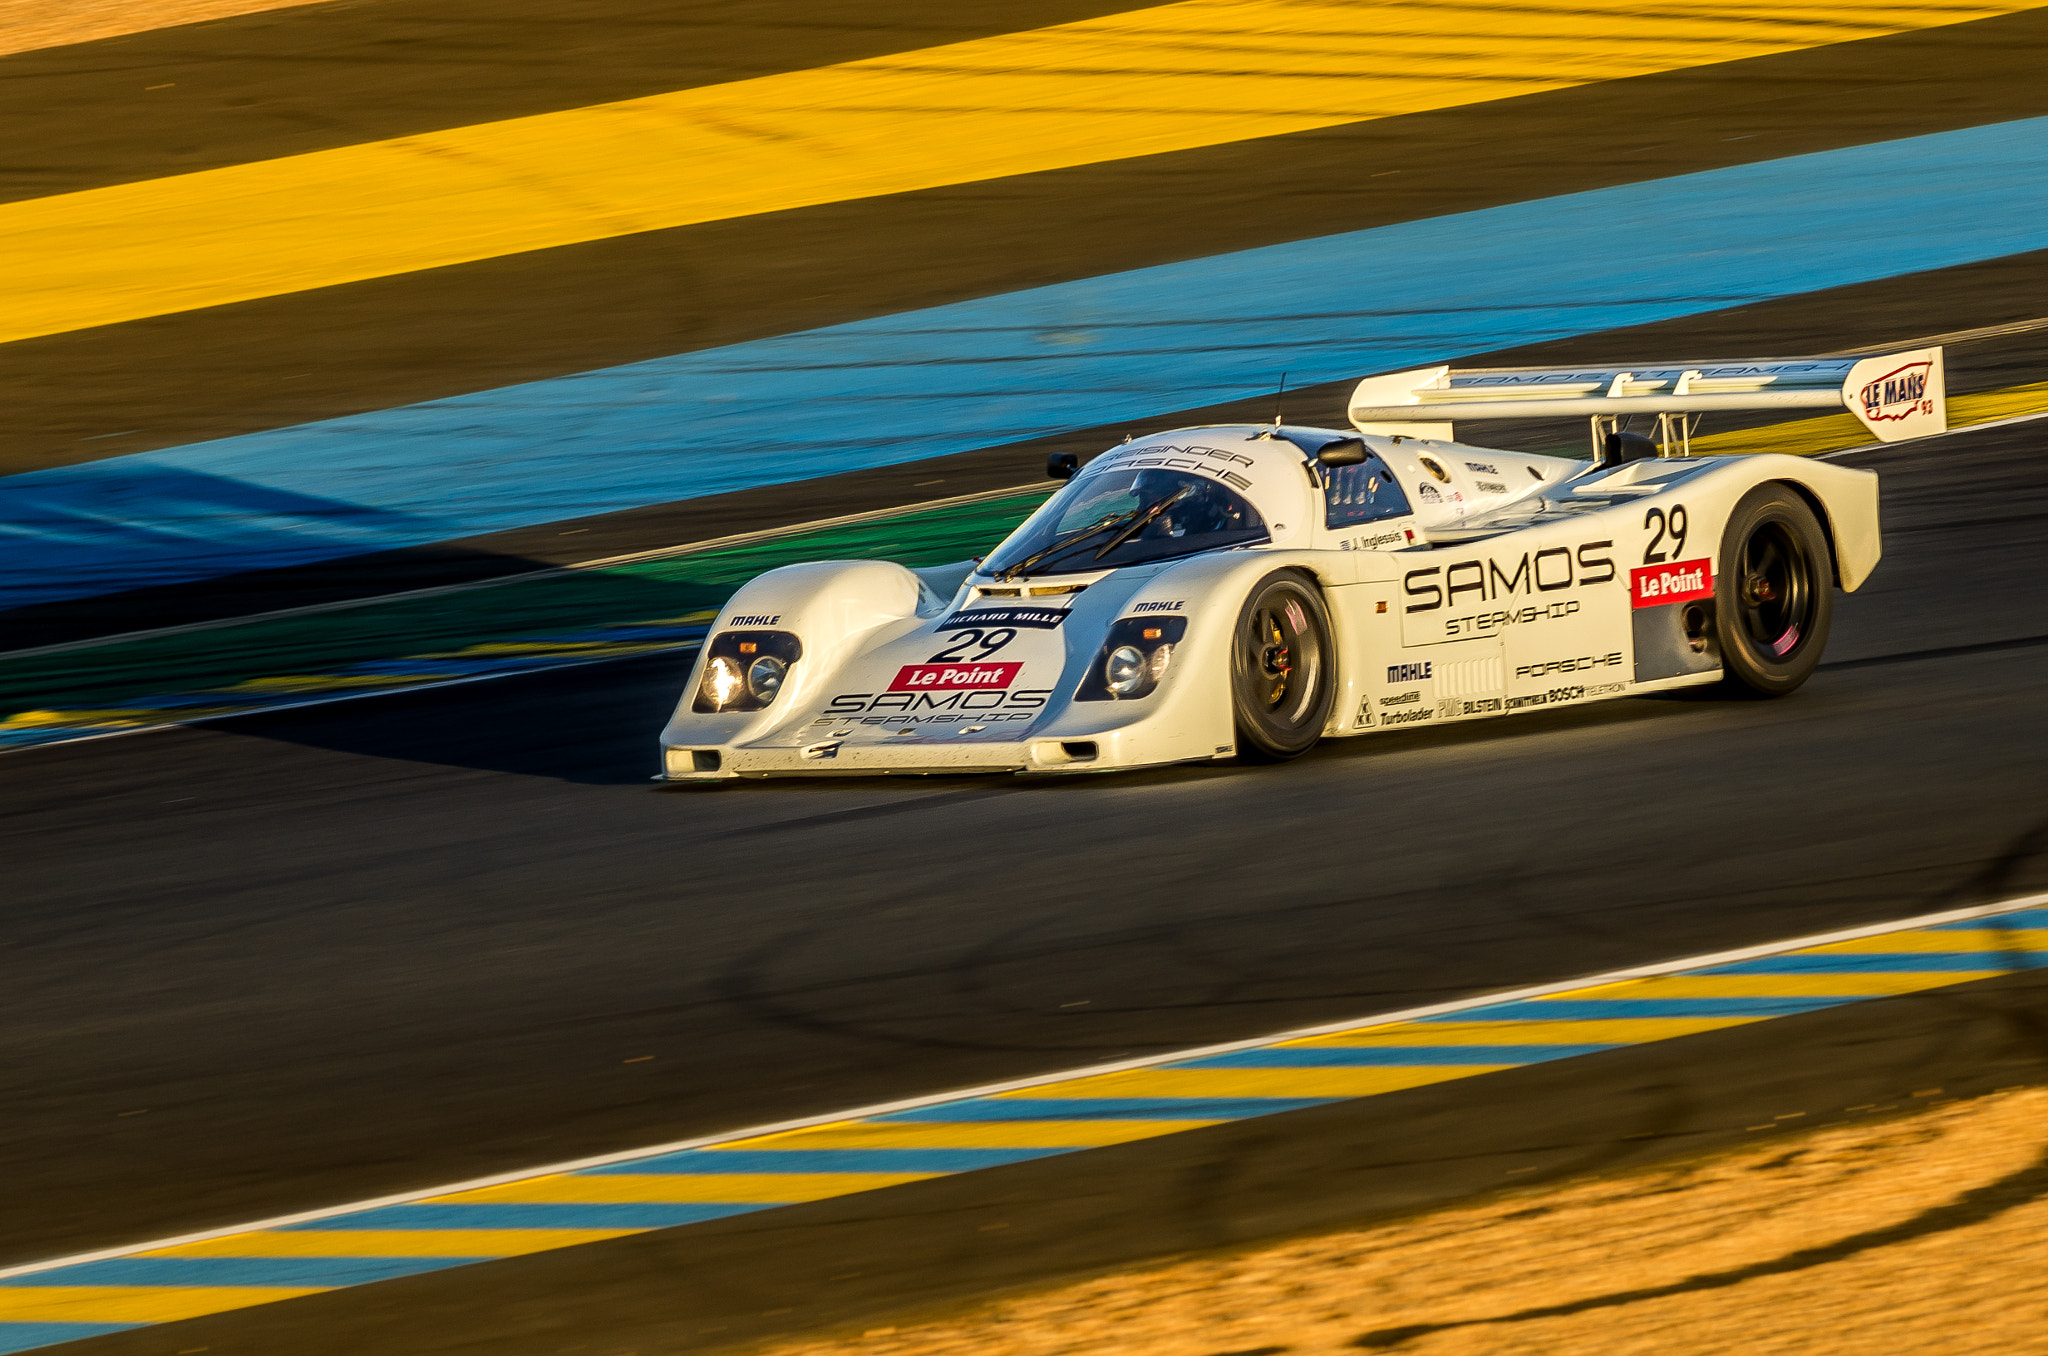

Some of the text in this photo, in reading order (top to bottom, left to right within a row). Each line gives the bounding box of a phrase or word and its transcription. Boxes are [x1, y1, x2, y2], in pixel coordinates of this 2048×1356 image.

[1866, 375, 1925, 409] LE MANS
[1643, 503, 1688, 565] 29
[1404, 540, 1615, 614] SAMOS
[1639, 567, 1705, 599] Le Point
[1133, 600, 1185, 613] MAHLE
[1445, 600, 1580, 636] STEAMSHIP
[730, 615, 781, 627] MAHLE
[926, 628, 1017, 664] 29
[906, 667, 1004, 686] Le Point
[1387, 661, 1432, 684] MAHLE
[1516, 652, 1622, 680] PORSCHE
[822, 689, 1053, 714] SAMOS
[1549, 685, 1584, 702] BOSCH
[1380, 708, 1434, 726] Turbolader
[1463, 698, 1502, 714] BILSTEIN
[810, 712, 1033, 727] STEAMSHIP
